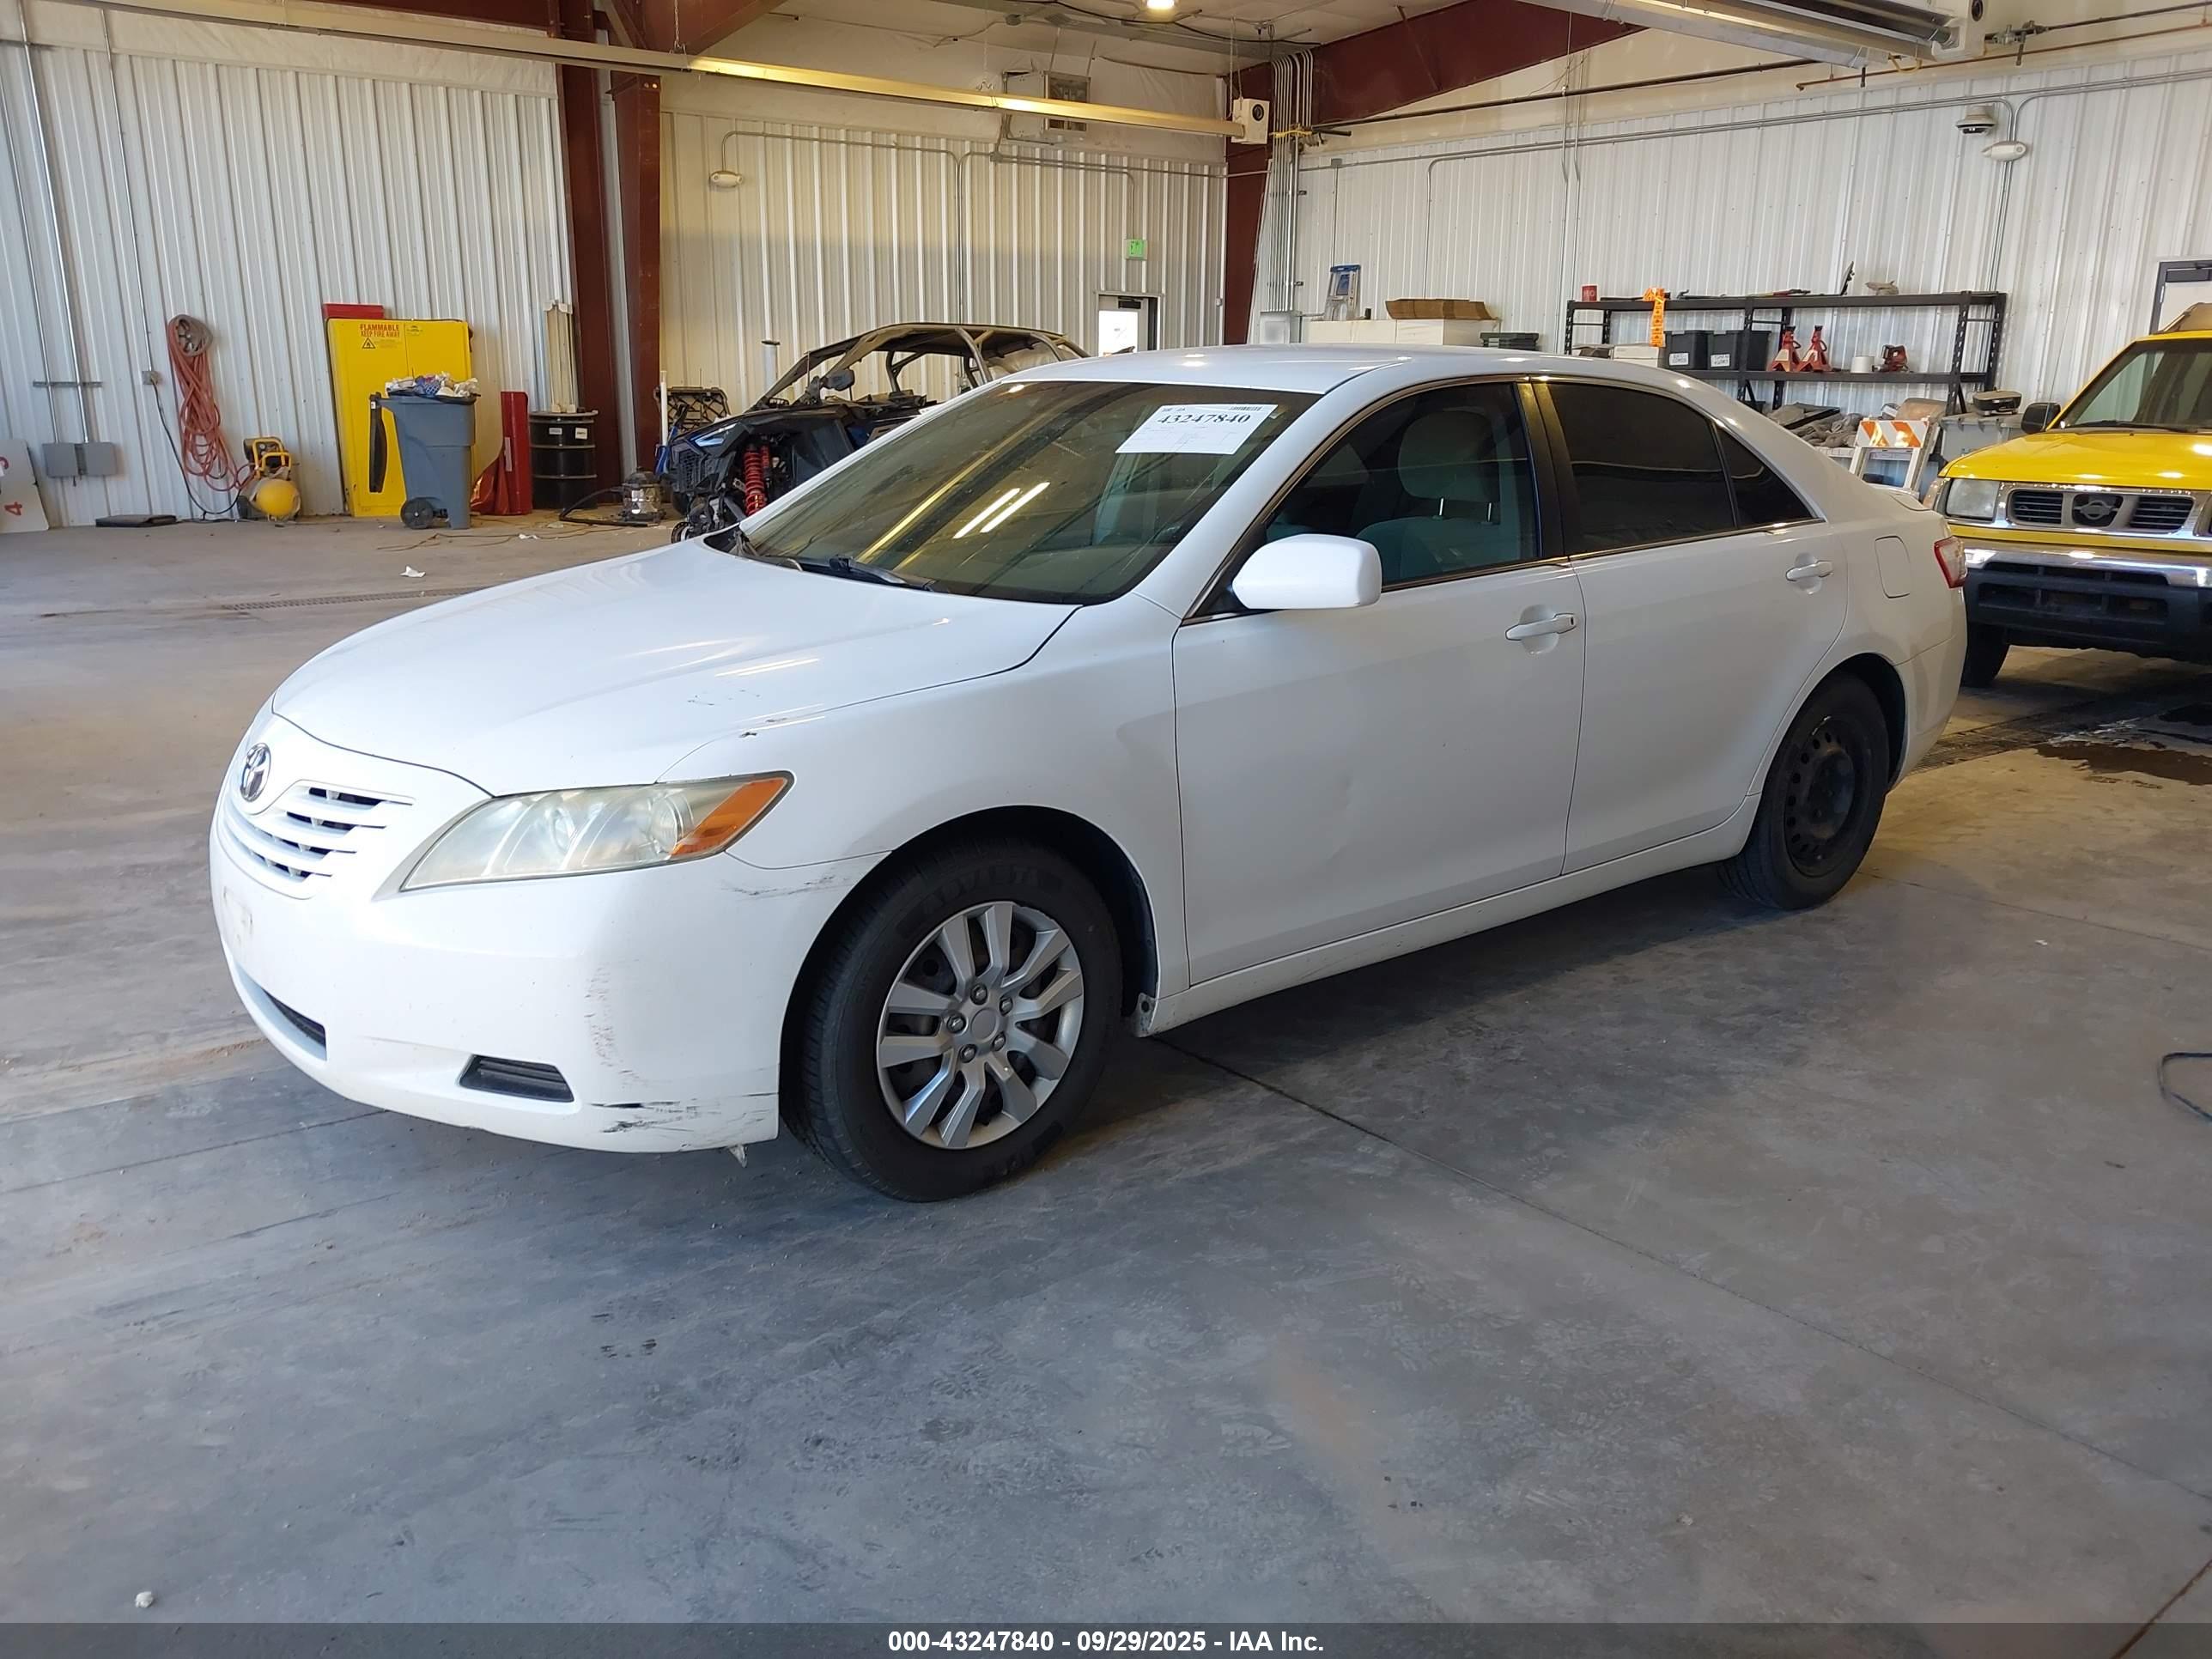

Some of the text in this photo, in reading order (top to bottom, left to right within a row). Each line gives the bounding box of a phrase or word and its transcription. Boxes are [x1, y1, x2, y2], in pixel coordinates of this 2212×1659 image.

[374, 331, 385, 339] FIRE
[386, 331, 399, 339] AWAY
[1157, 413, 1251, 424] 43247840
